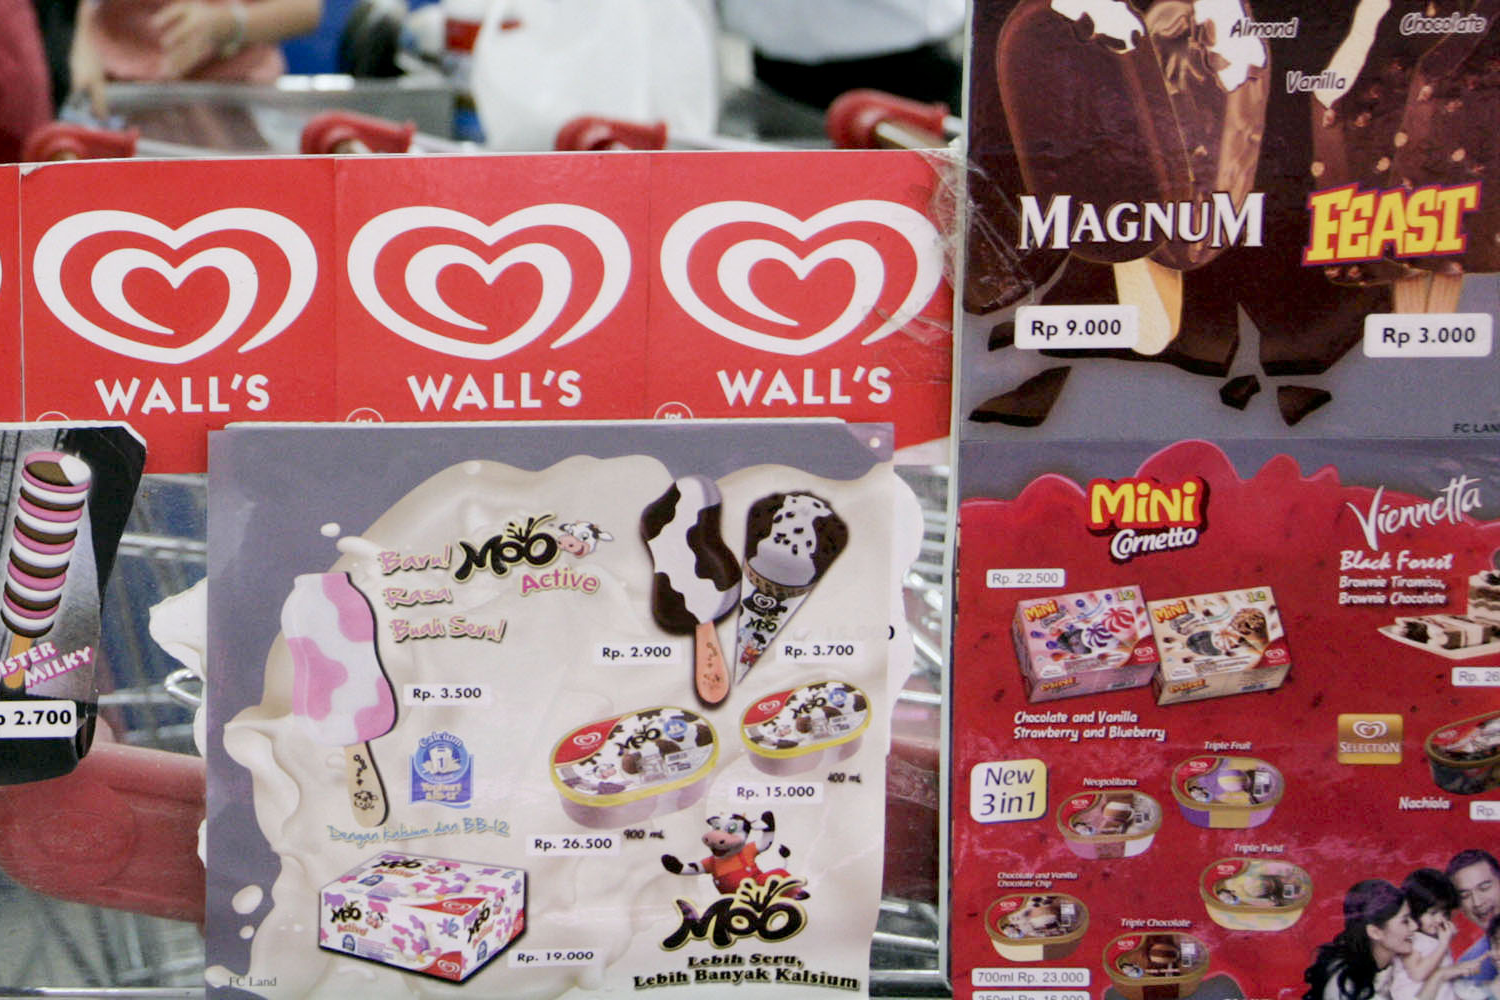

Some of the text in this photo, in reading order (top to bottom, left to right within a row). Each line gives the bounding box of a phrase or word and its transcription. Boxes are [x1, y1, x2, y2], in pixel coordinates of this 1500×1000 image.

[1230, 17, 1299, 39] Almond
[1399, 12, 1487, 36] Chocolate
[1286, 70, 1348, 93] Vanilla
[1303, 182, 1482, 266] FEAST
[1031, 319, 1122, 340] Rp 9.000
[1383, 326, 1476, 347] Rp 3.000
[95, 374, 269, 416] WALL'S
[407, 369, 583, 412] WALL'S
[717, 366, 892, 409] WALL'S
[1346, 474, 1482, 551] Viennetta
[1111, 527, 1198, 560] Cornetto
[379, 544, 453, 575] Baru!
[1340, 550, 1454, 571] Black Forest
[520, 567, 601, 596] Active
[992, 573, 1012, 586] Rp.
[1339, 576, 1387, 588] Brownie
[384, 588, 453, 608] Rasa
[1338, 592, 1447, 605] Brownie Chocolate
[390, 615, 507, 643] Buah Seru!
[602, 646, 671, 660] Rp. 2.900
[784, 644, 854, 659] Rp. 3.700
[23, 646, 94, 689] MILKY
[413, 687, 482, 701] Rp. 3.500
[14, 709, 72, 726] 2.700
[1014, 710, 1138, 724] Chocolate and Vanilla
[1014, 725, 1165, 742] Strawberry and Blueberry
[985, 767, 1034, 786] New
[736, 785, 815, 799] Rp. 15.000
[534, 837, 612, 851] Rp. 26.500
[517, 951, 594, 964] Rp. 19.000
[687, 954, 743, 967] Lebih
[250, 976, 277, 987] Land
[634, 967, 860, 990] Lebih Banyak Kalsium
